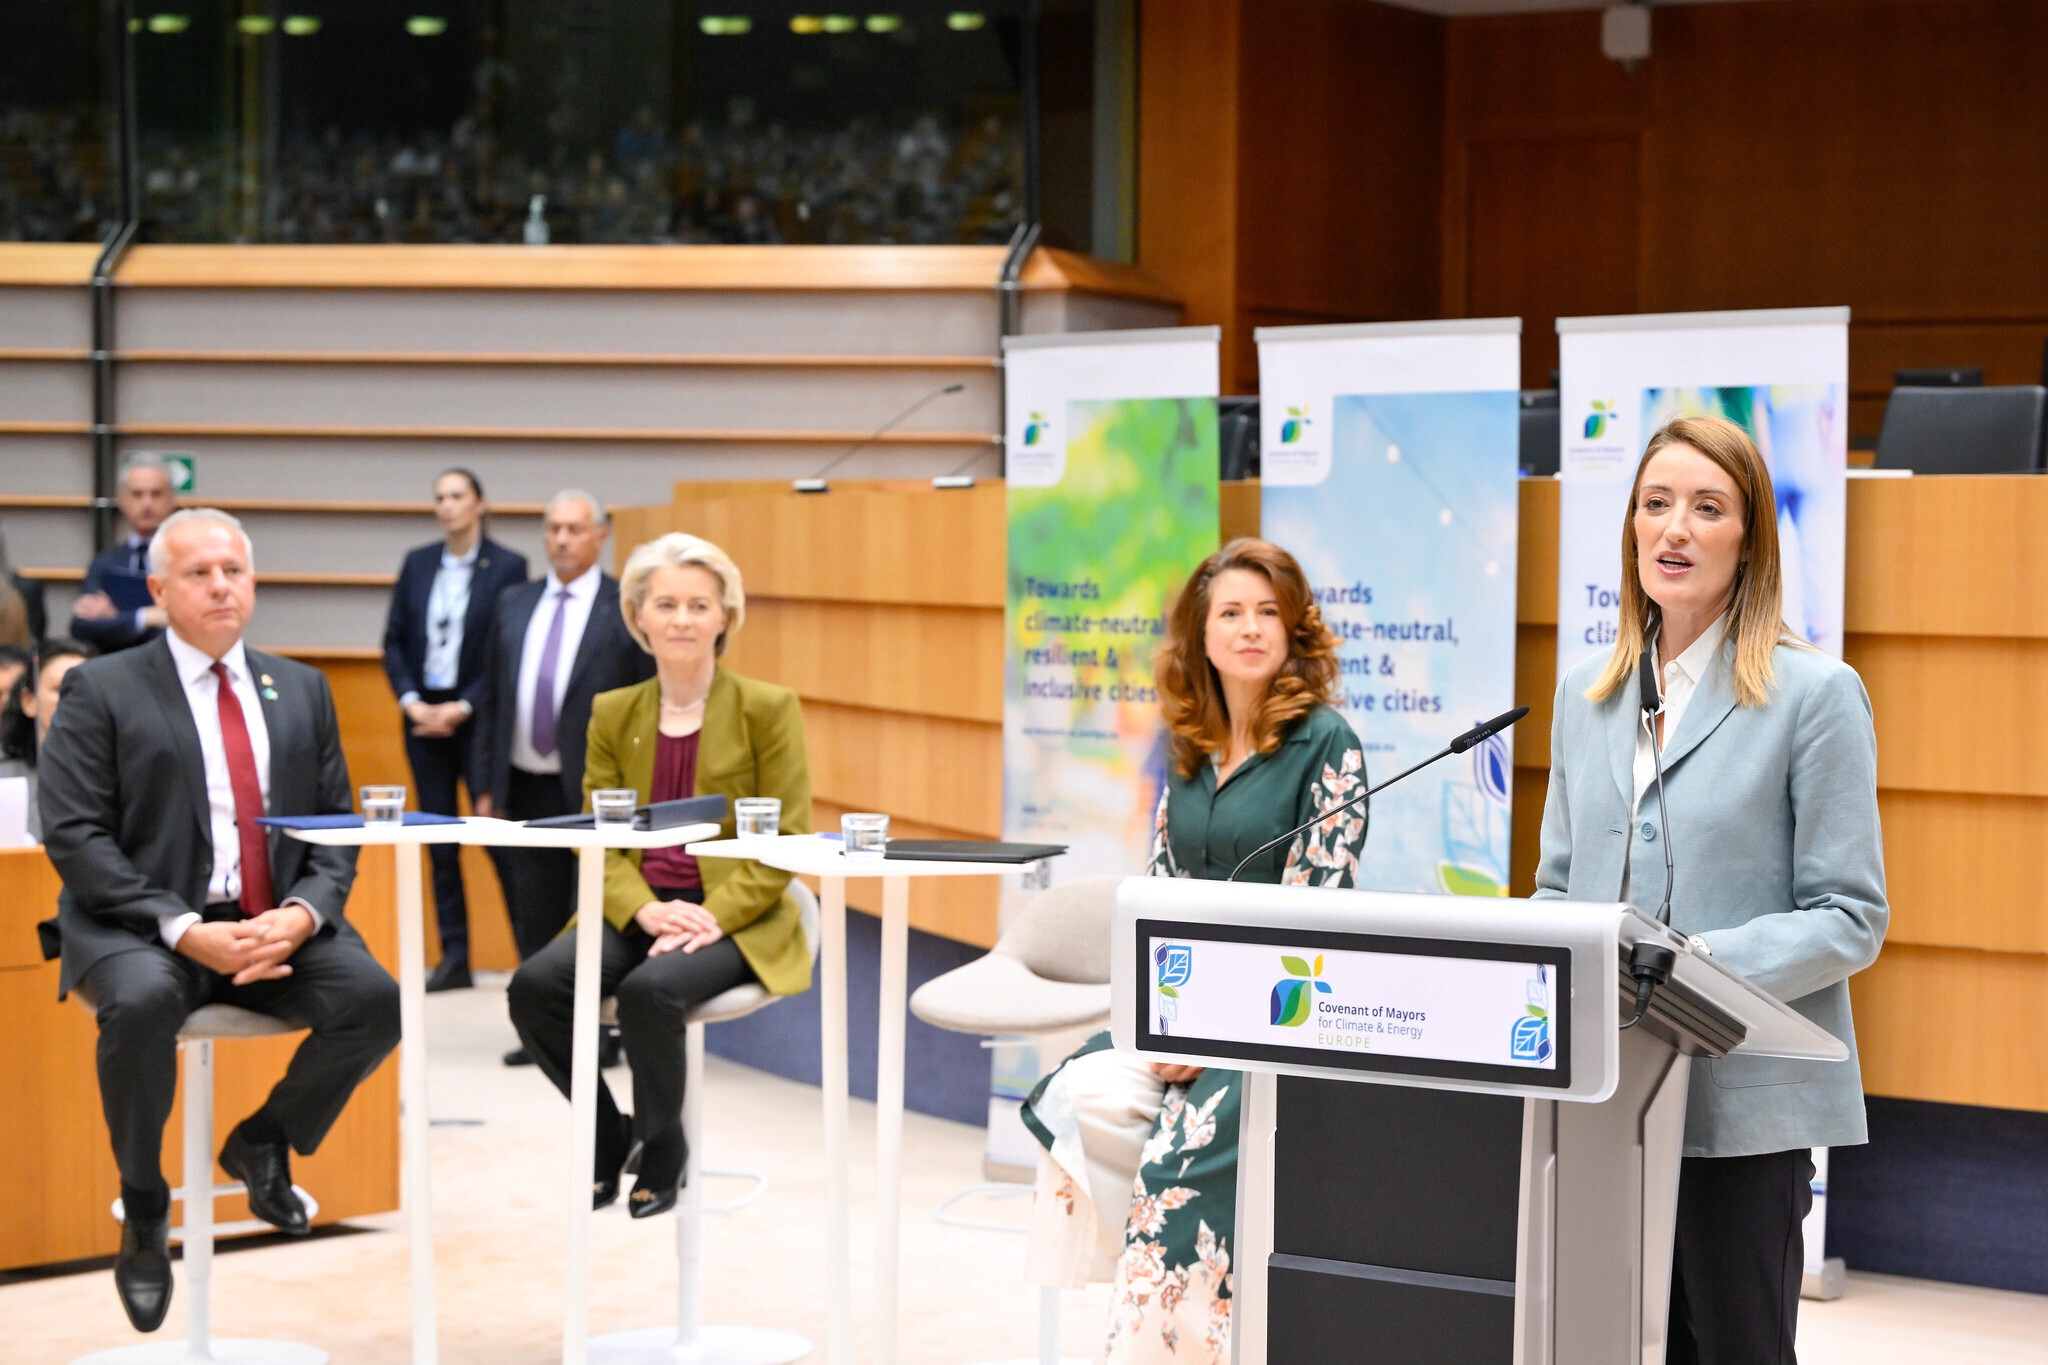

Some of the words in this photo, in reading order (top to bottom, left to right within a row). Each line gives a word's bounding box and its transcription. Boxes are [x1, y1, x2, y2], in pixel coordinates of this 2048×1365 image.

[1026, 577, 1099, 599] Towards
[1024, 644, 1098, 667] resilient
[1104, 648, 1119, 669] &
[1378, 653, 1395, 676] &
[1023, 676, 1102, 701] inclusive
[1383, 688, 1442, 713] cities
[1318, 1001, 1369, 1016] Covenant
[1371, 1006, 1383, 1017] of
[1386, 1007, 1426, 1022] Mayors
[1318, 1016, 1332, 1029] for
[1335, 1018, 1374, 1032] Climate
[1376, 1021, 1385, 1034] &
[1387, 1022, 1423, 1040] Energy
[1318, 1033, 1370, 1049] EUROPE
